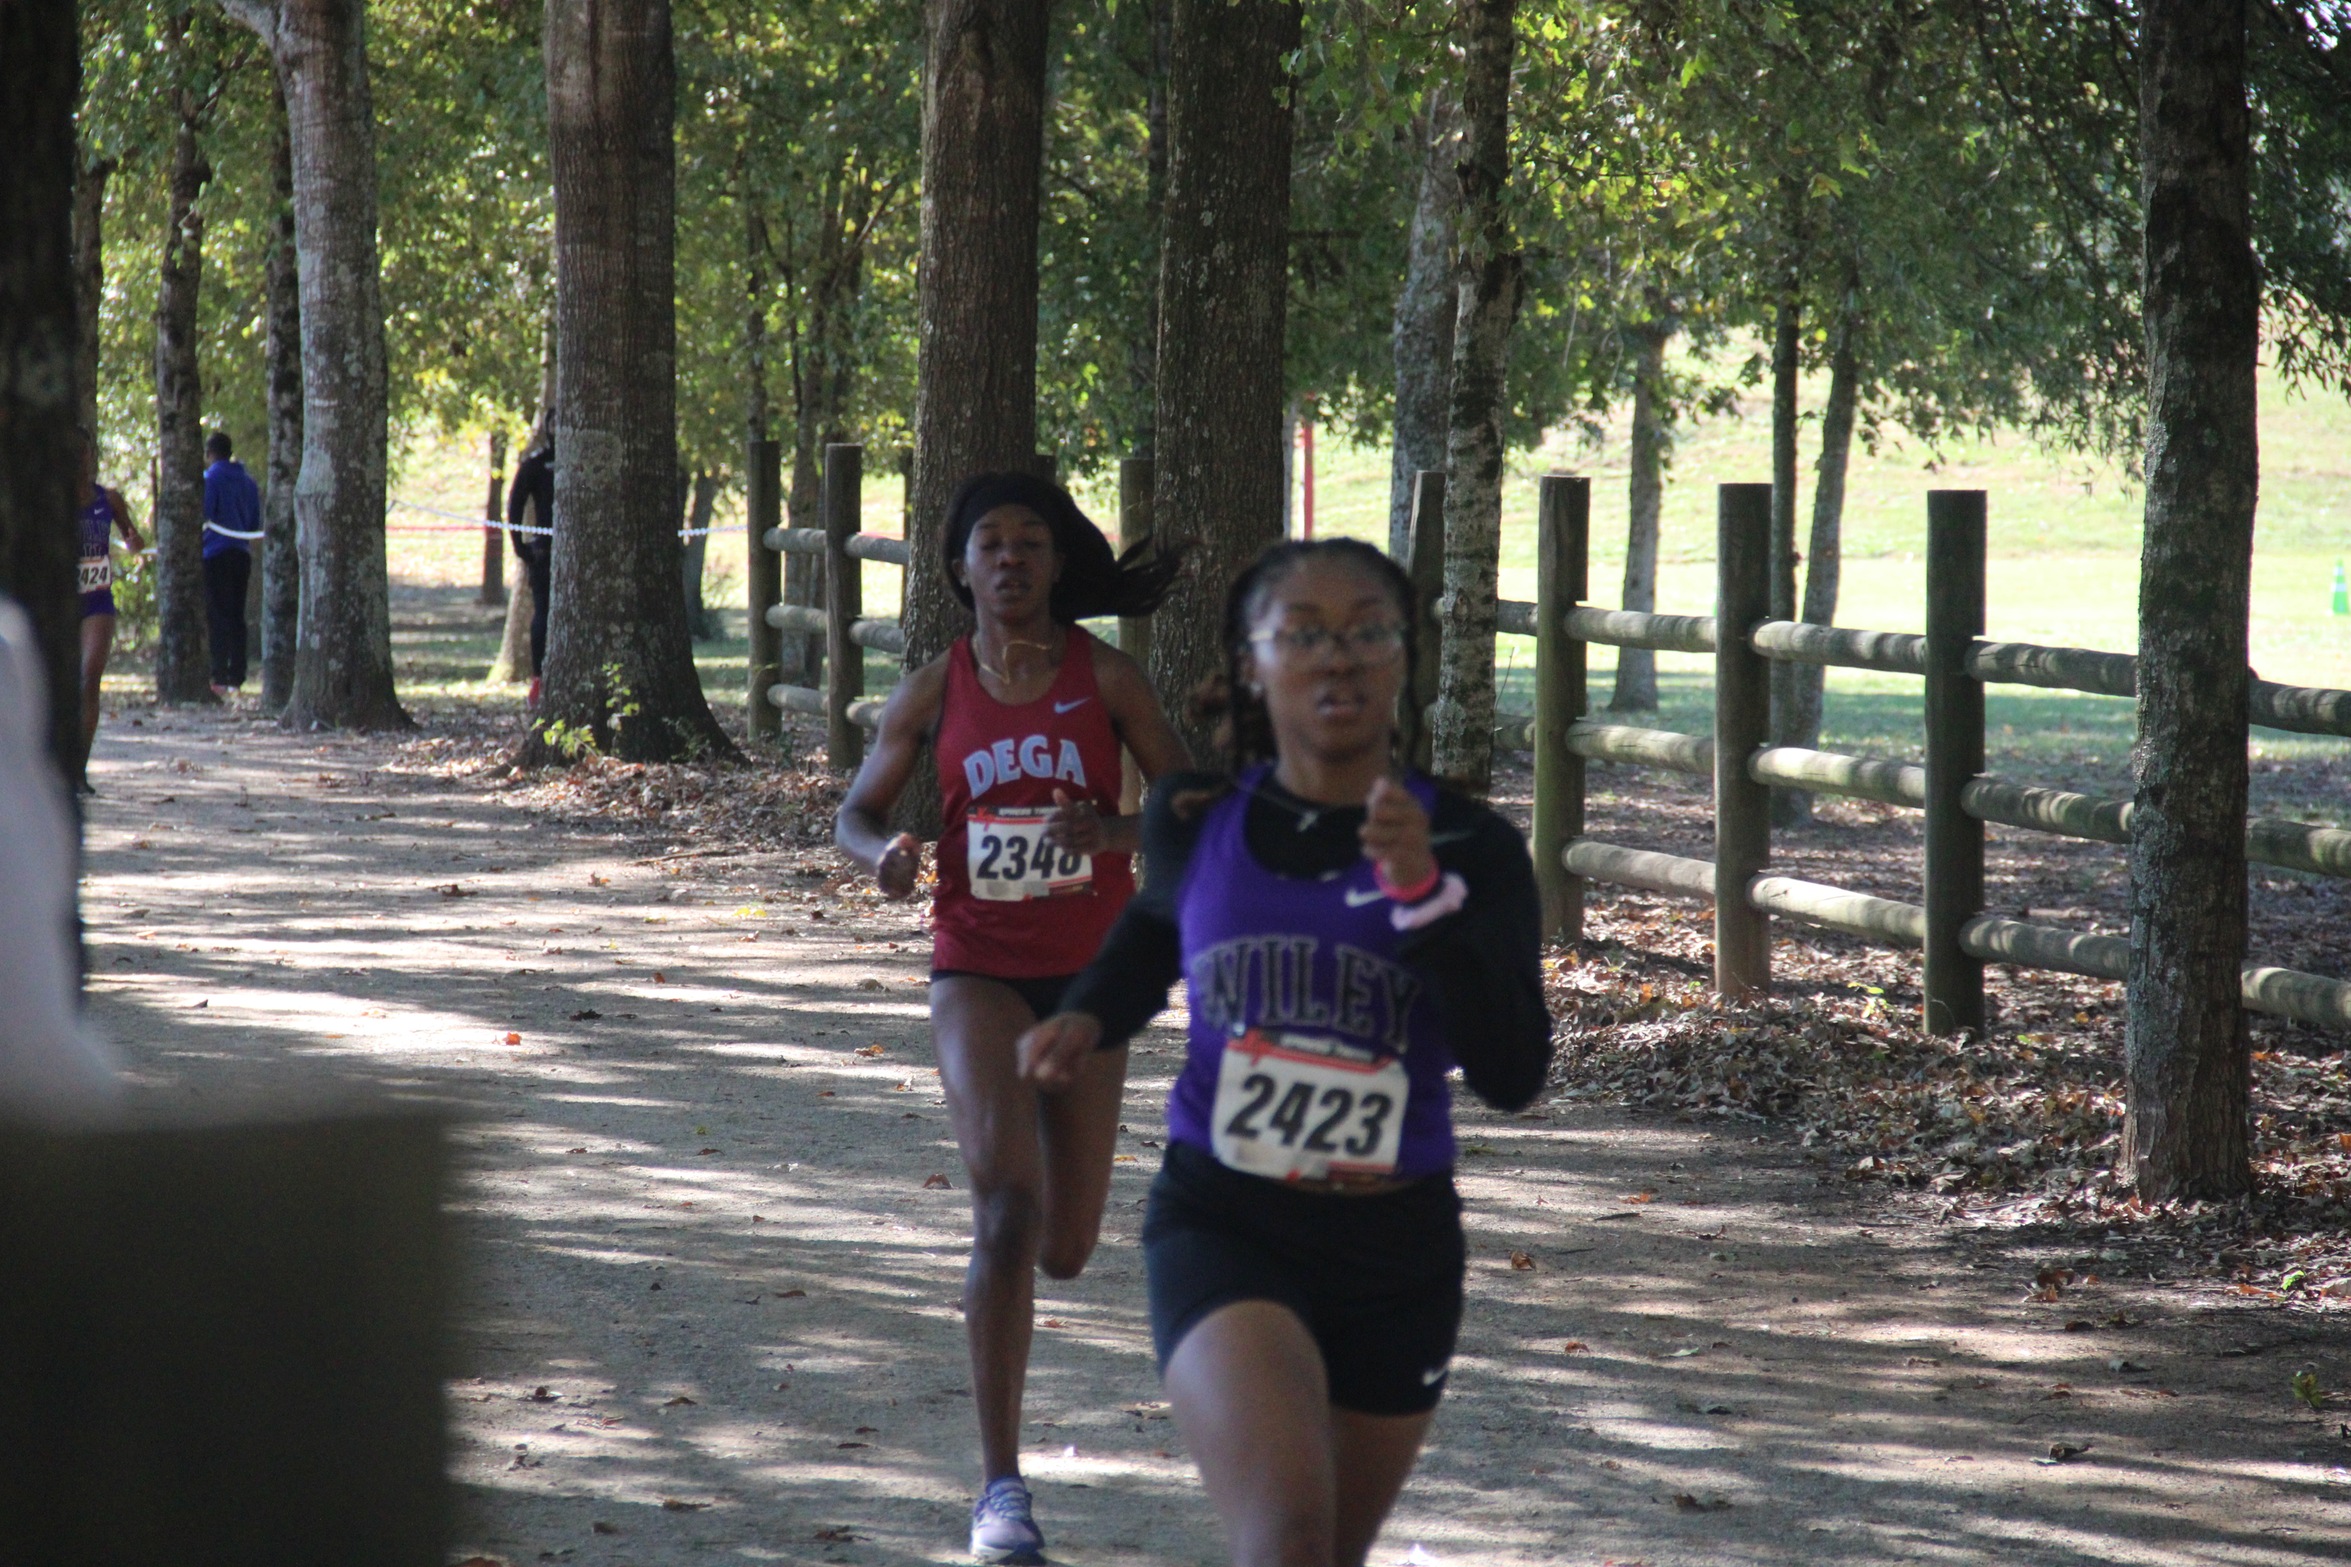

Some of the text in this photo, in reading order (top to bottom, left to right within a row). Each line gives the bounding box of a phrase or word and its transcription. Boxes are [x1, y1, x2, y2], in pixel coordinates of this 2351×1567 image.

[963, 734, 1087, 800] DEGA
[1192, 933, 1421, 1054] WILEY
[1226, 1073, 1393, 1157] 2423
